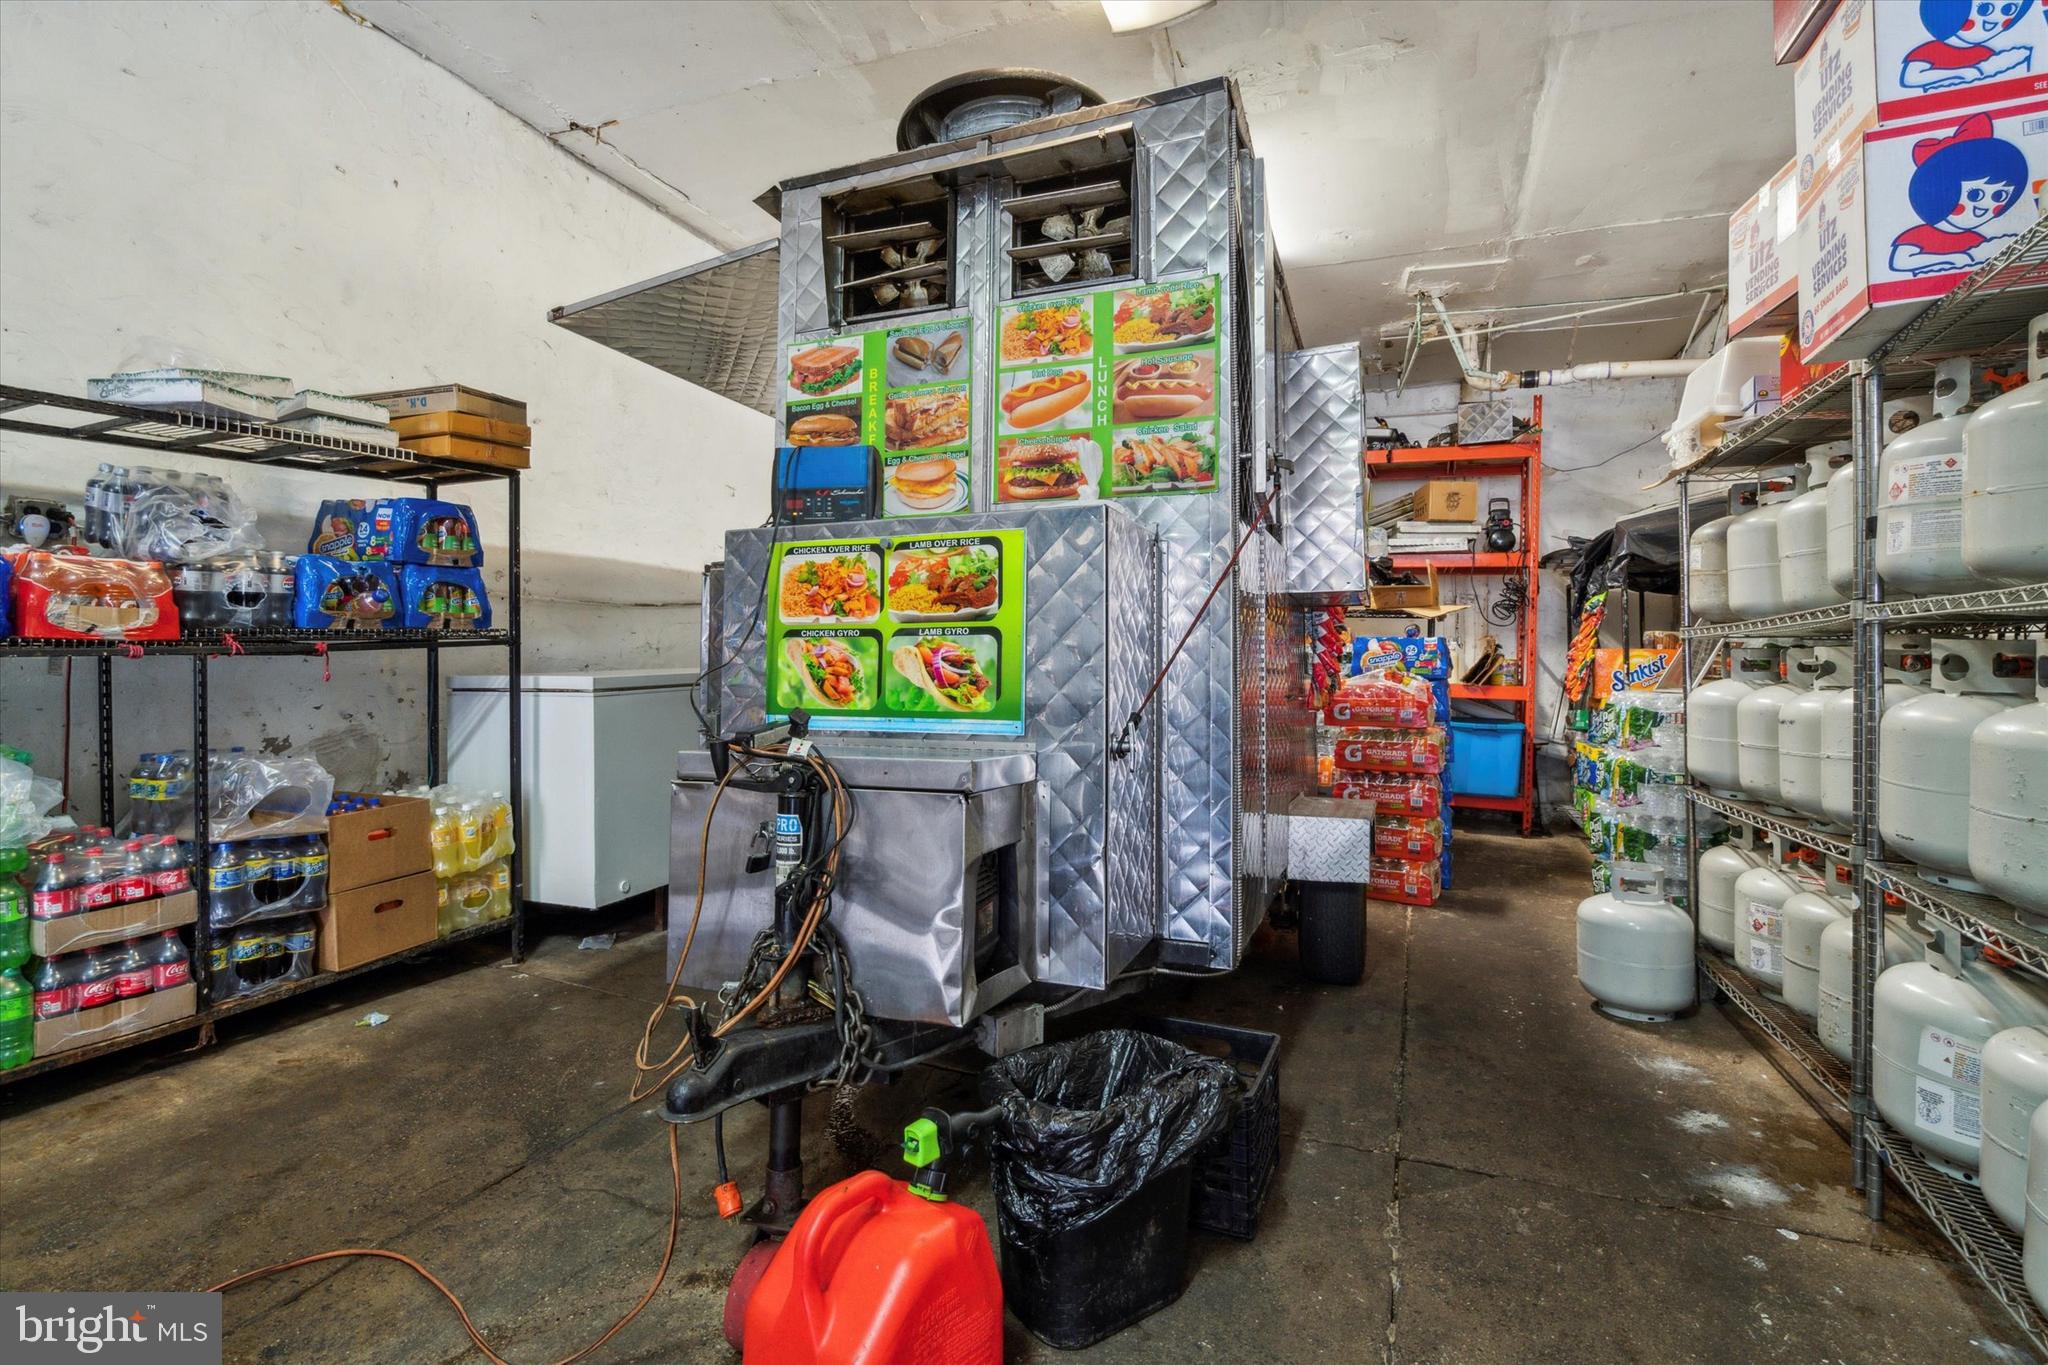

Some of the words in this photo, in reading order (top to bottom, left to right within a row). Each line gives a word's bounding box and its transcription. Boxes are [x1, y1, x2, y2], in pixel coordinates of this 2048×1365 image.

[1812, 61, 1852, 122] VENDING
[1813, 80, 1853, 139] SERVICES
[1812, 232, 1847, 280] VENDING
[1745, 257, 1779, 292] VENDING
[1813, 250, 1847, 298] SERVICES
[1180, 280, 1200, 290] Rice
[1745, 270, 1779, 305] SERVICES
[1017, 301, 1047, 313] Chicken
[1066, 297, 1084, 306] Rice
[1141, 357, 1156, 366] Hot
[1157, 353, 1193, 365] Sausage
[1032, 369, 1046, 379] Hot
[1047, 367, 1063, 378] Dog
[1097, 357, 1107, 427] LUNCH
[791, 404, 811, 412] Bacon
[812, 402, 824, 411] Egg
[869, 368, 879, 446] BREAKF
[1136, 425, 1169, 436] Chicken
[1172, 422, 1198, 433] Salad
[1018, 435, 1072, 446] Cheeseburger
[887, 457, 901, 466] Egg
[947, 450, 966, 460] Bagel
[321, 535, 353, 553] snapple
[793, 546, 827, 556] CHICKEN
[828, 545, 850, 554] OVER
[851, 543, 871, 553] RICE
[909, 540, 933, 550] LAMB
[934, 539, 958, 549] OVER
[960, 537, 981, 547] RICE
[801, 629, 836, 638] CHICKEN
[837, 629, 861, 637] GYRO
[919, 628, 943, 637] LAMB
[944, 627, 970, 637] GYRO
[1368, 652, 1401, 665] snapple
[1611, 654, 1668, 692] Snkist
[1333, 703, 1350, 720] G
[1344, 744, 1362, 762] G
[1366, 748, 1408, 757] GATORADE
[1364, 790, 1406, 800] GATORADE
